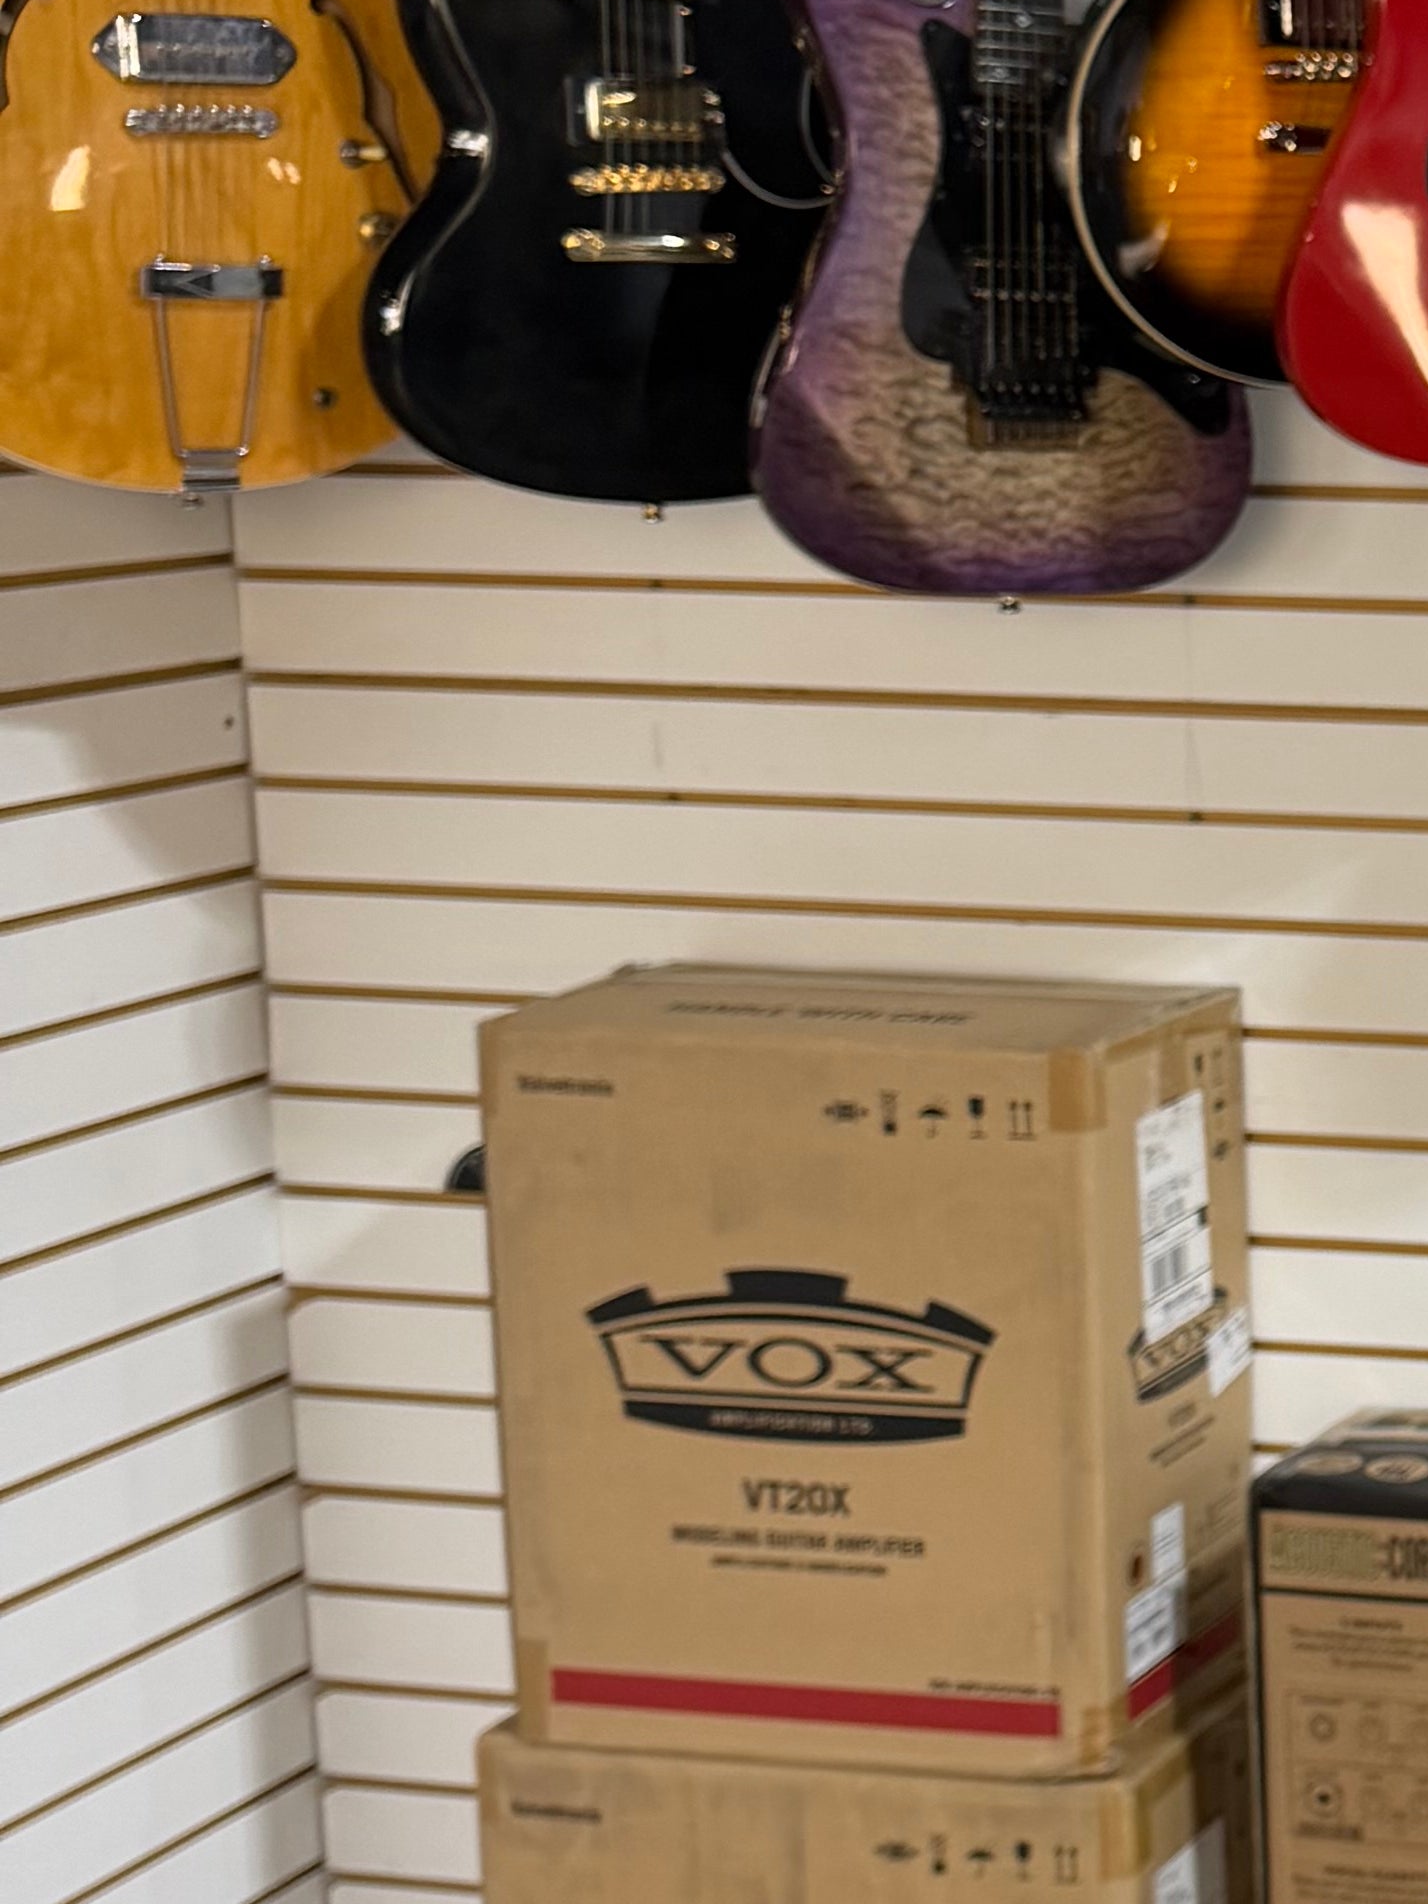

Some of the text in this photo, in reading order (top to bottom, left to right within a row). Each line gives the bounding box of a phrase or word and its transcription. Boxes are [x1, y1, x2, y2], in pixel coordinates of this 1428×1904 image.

[640, 1333, 936, 1395] VOX
[740, 1475, 853, 1518] VT20X
[766, 1527, 827, 1553] GUITAR
[832, 1532, 927, 1560] AMPLIFIER
